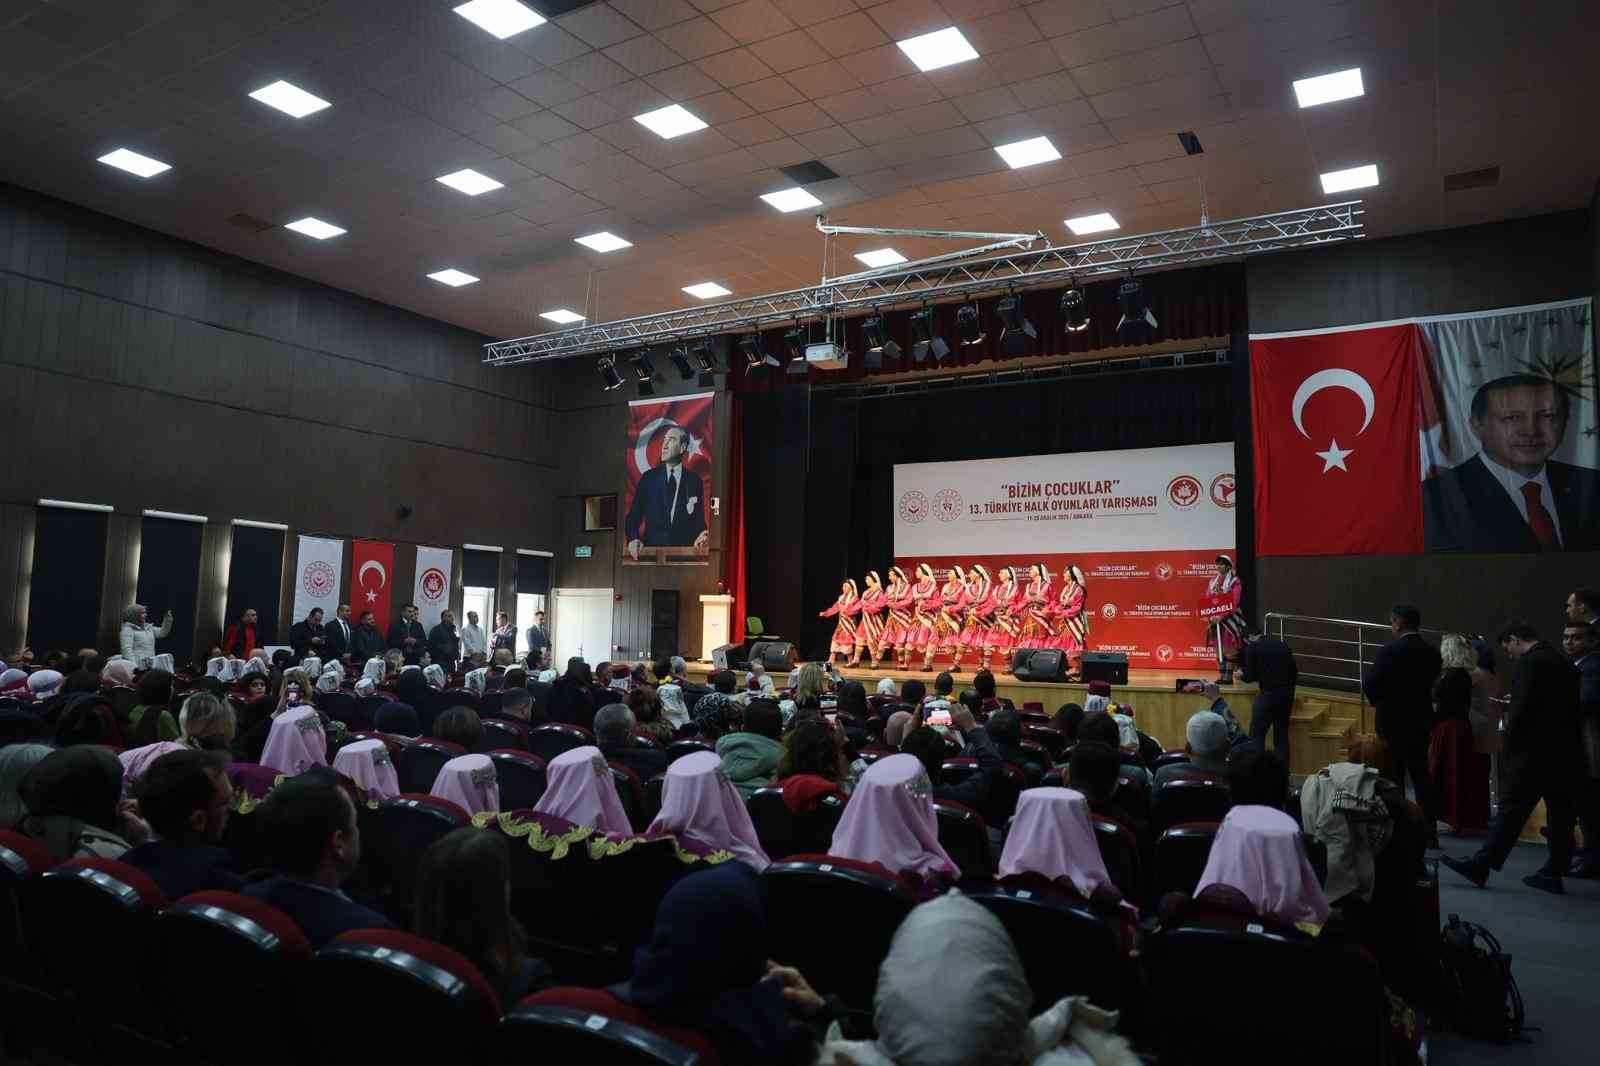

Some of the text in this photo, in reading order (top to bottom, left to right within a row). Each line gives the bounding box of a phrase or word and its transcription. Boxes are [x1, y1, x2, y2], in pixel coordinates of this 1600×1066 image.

[969, 496, 1157, 514] 13. TÜRKİYE HALK OYUNLARI YARIŞMASI
